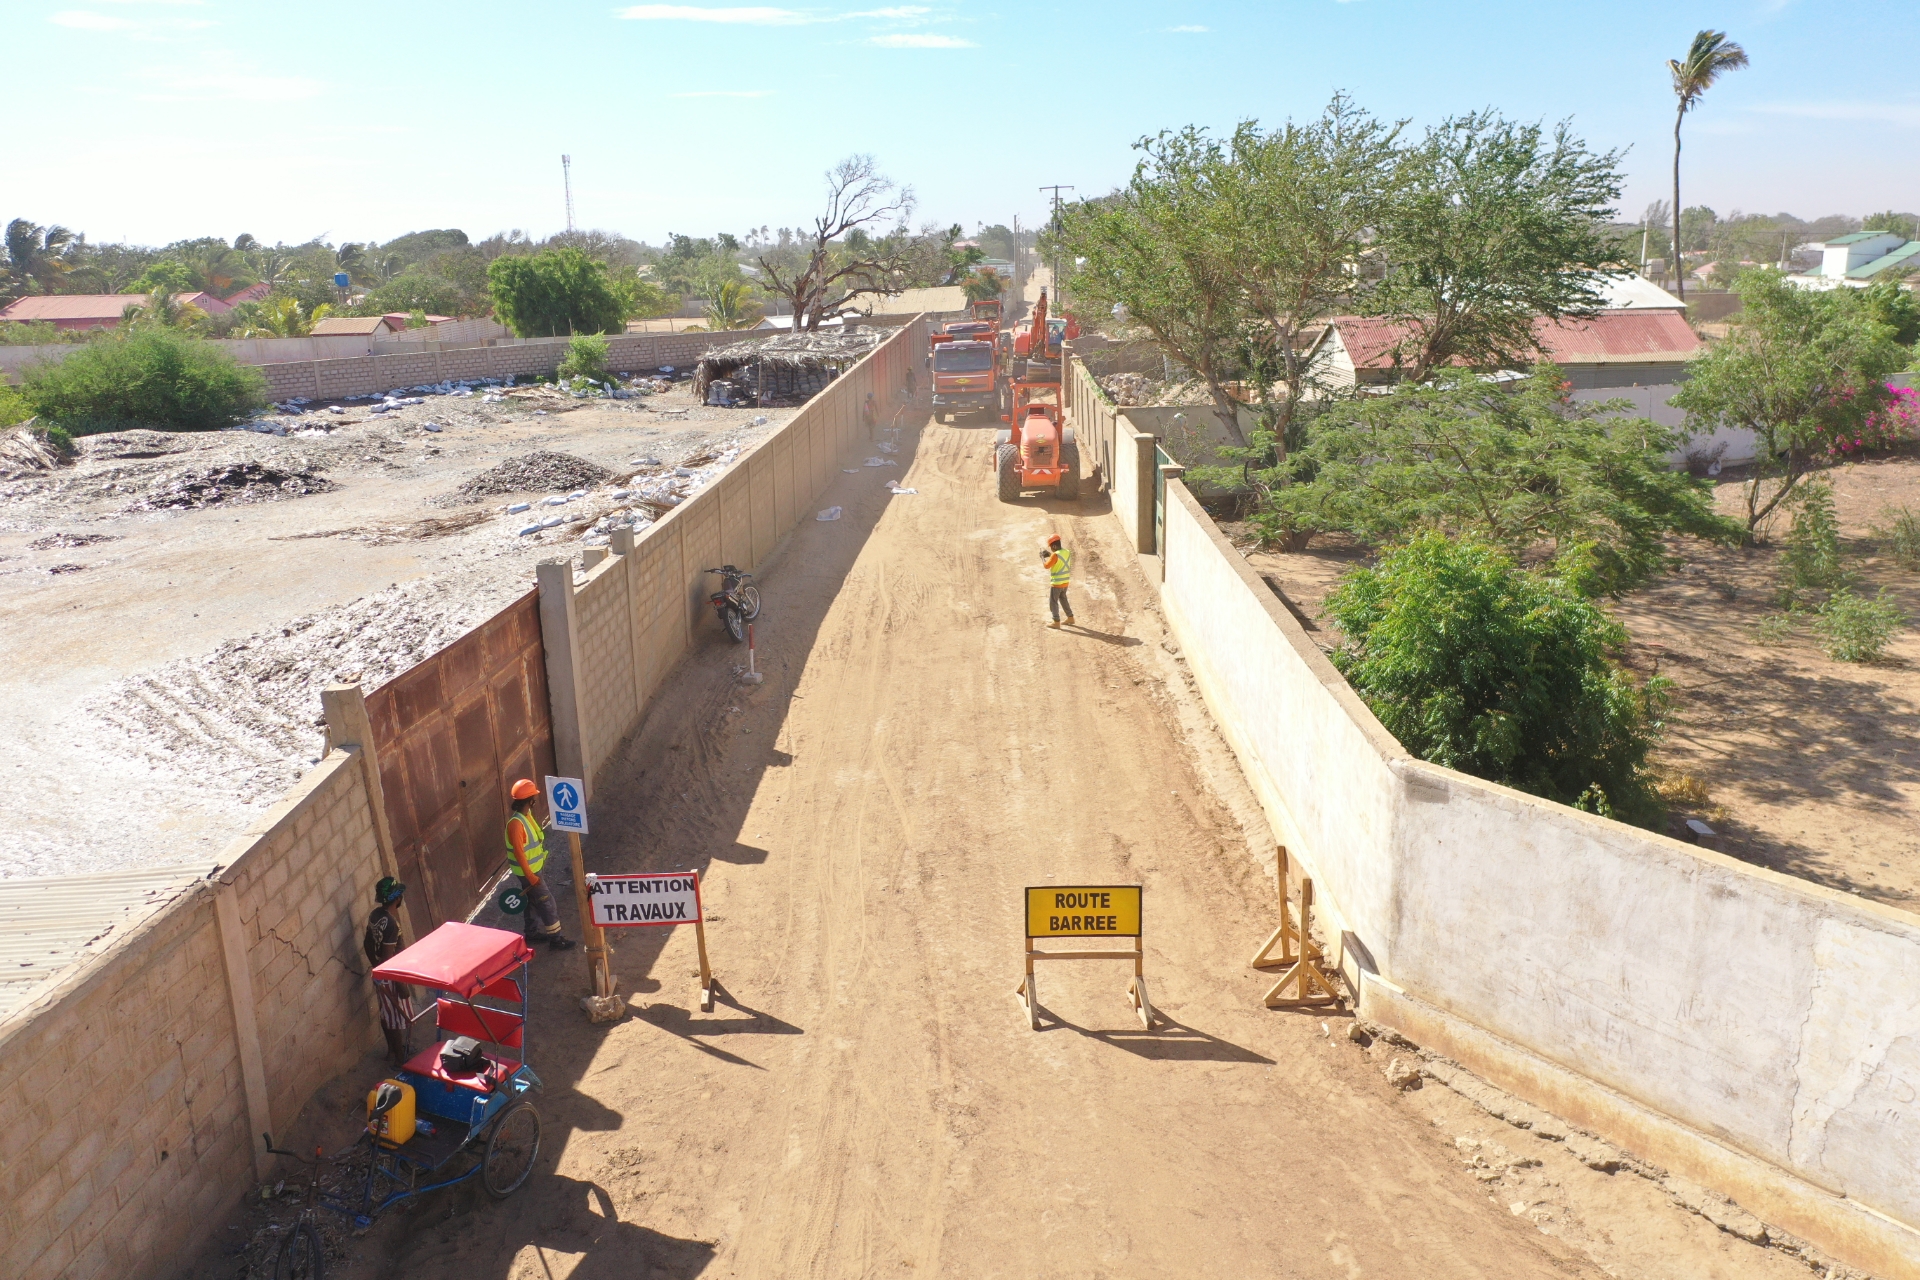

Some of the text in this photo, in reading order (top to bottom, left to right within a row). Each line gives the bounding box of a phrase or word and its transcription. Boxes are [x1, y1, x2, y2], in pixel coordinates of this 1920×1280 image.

[591, 879, 695, 895] ATTENTION
[504, 894, 521, 909] GO
[1055, 893, 1110, 908] ROUTE
[604, 902, 687, 921] TRAVAUX
[1049, 916, 1117, 931] BARREE
